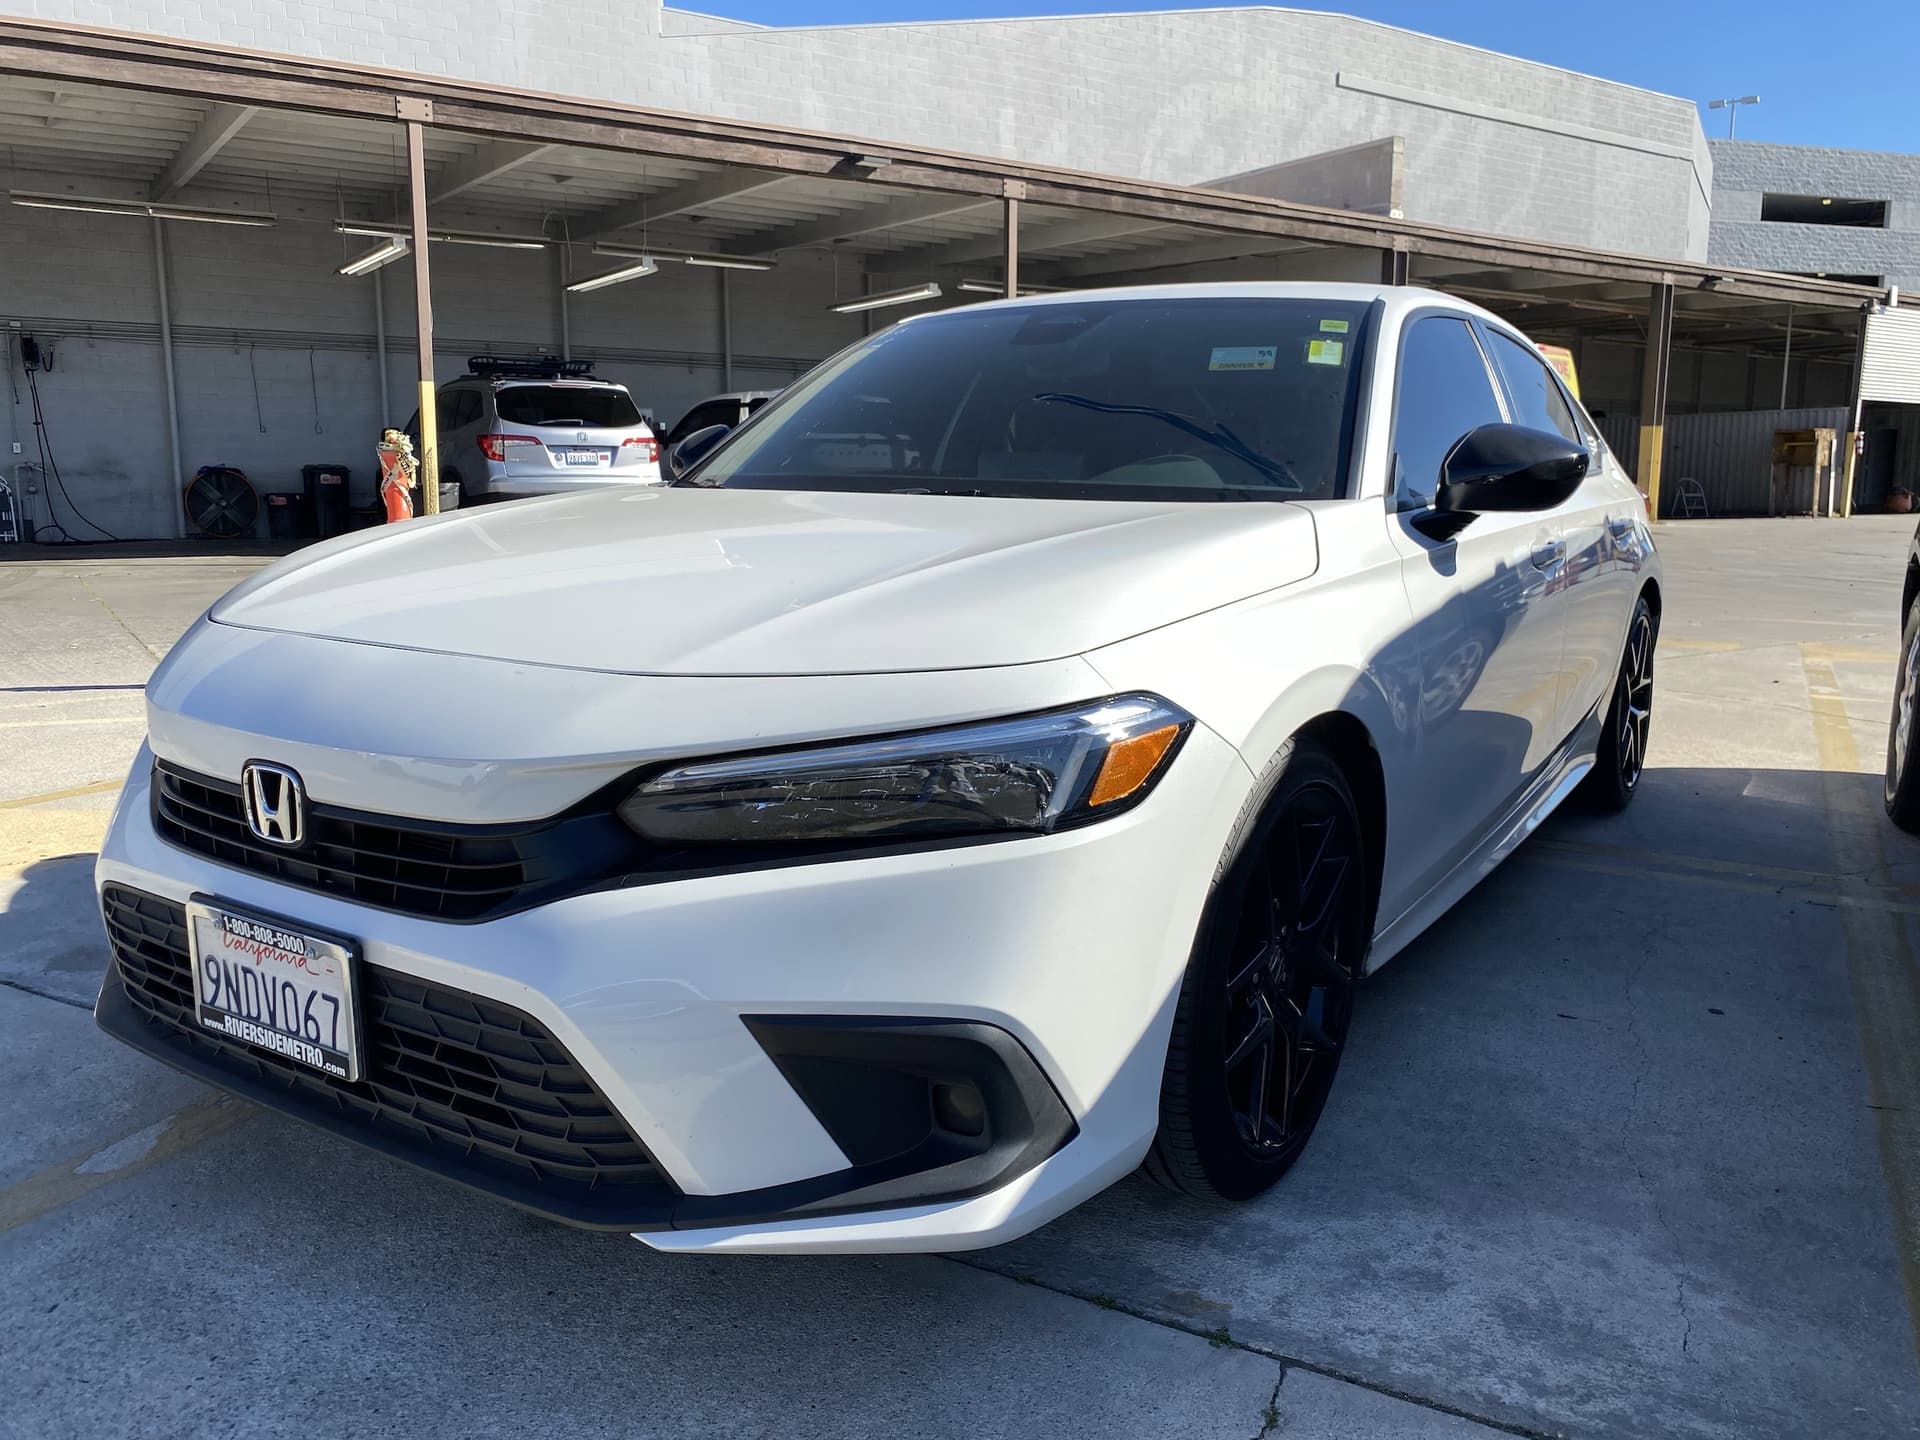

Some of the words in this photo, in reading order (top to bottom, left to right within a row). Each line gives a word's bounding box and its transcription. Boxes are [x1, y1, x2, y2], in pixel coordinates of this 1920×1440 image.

[223, 915, 304, 954] 1-800-808-5000
[201, 954, 340, 1050] 9NDV067
[204, 1014, 346, 1077] www.RIVERSIDEMETRO.com
